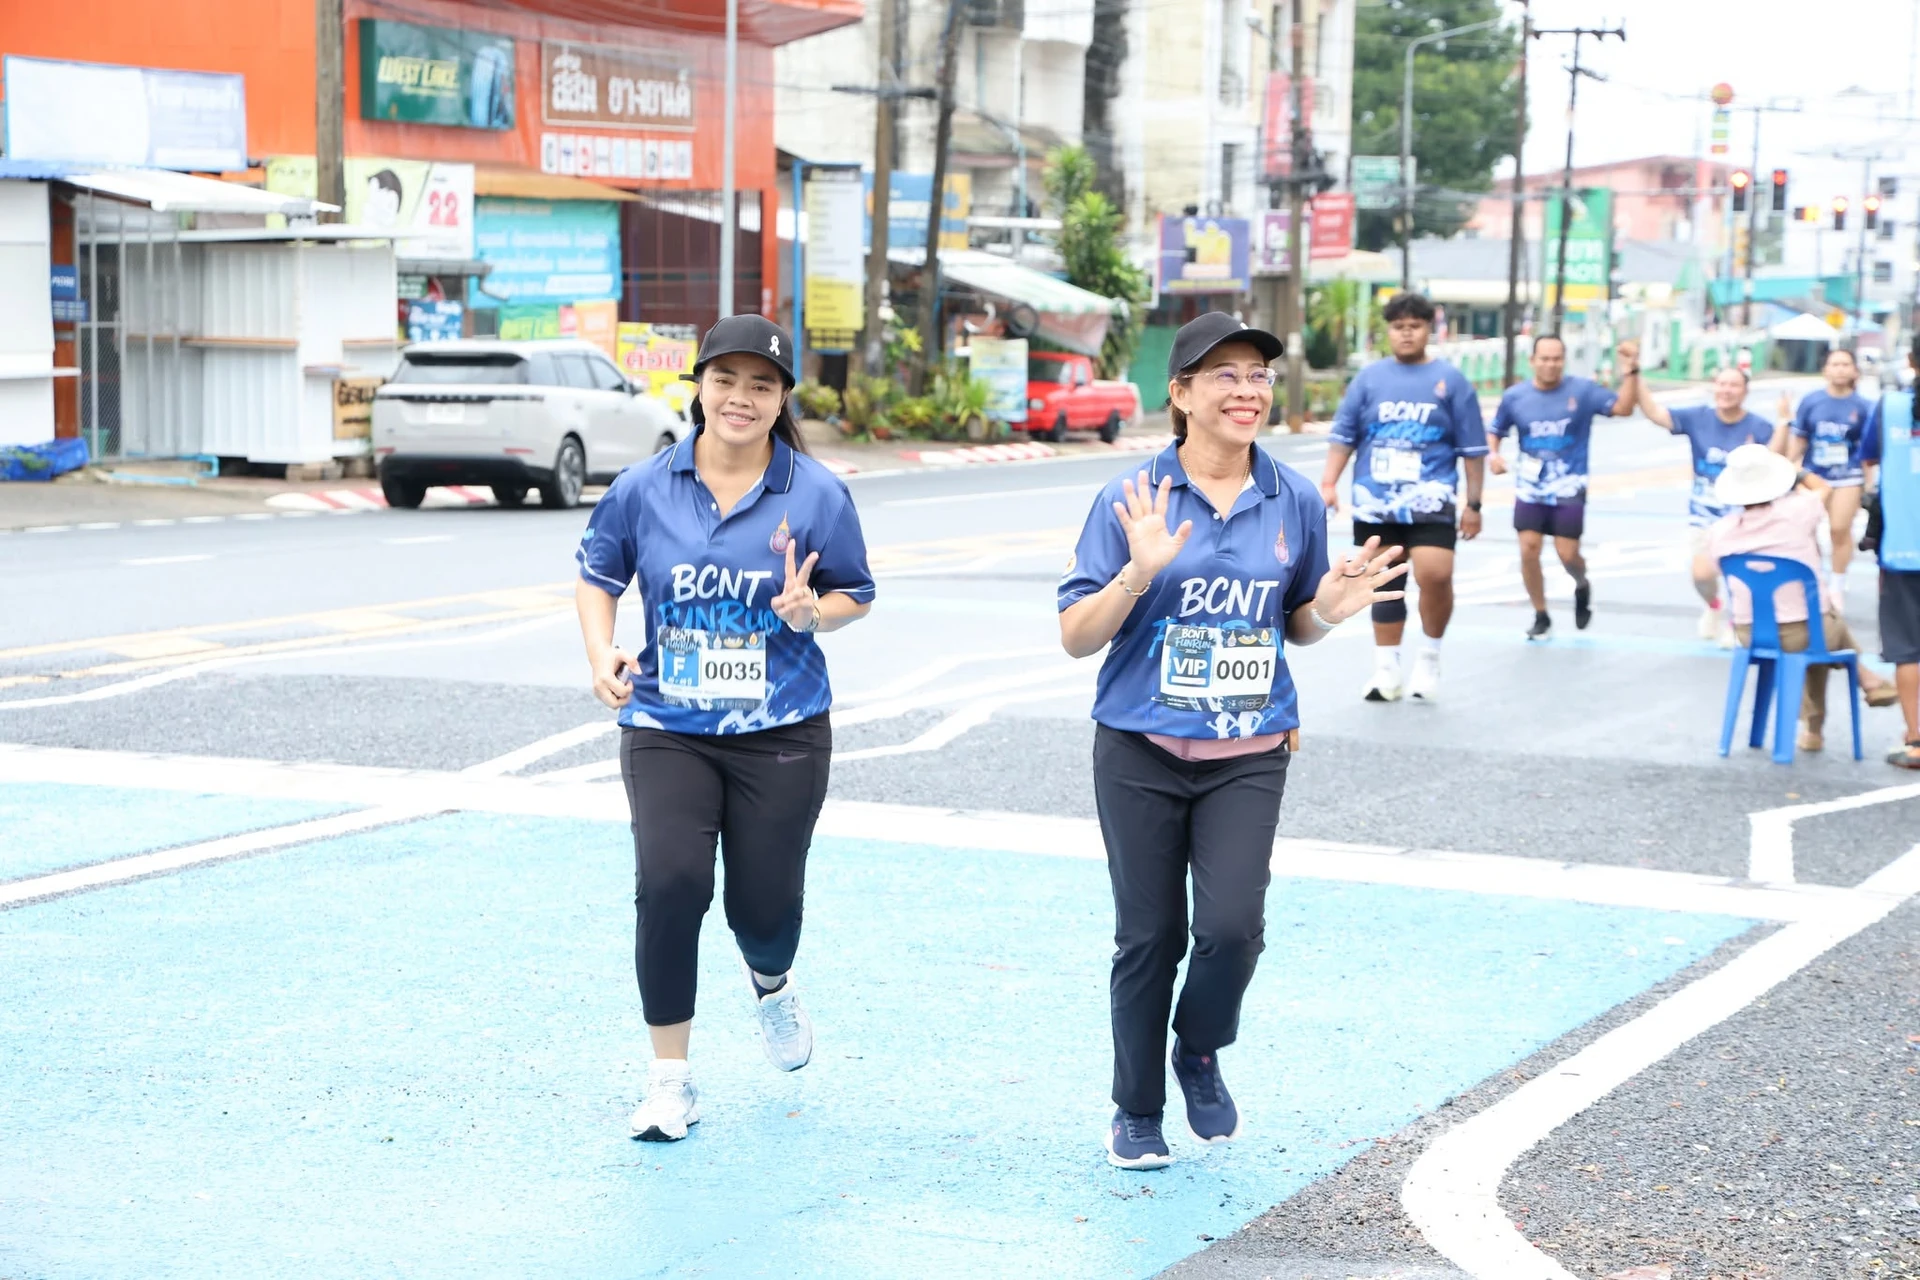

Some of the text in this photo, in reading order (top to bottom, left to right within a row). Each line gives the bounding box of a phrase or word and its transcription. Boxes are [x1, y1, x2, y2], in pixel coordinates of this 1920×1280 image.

[428, 190, 460, 226] 22
[1378, 400, 1438, 424] BCNT
[671, 563, 773, 608] BCNT
[1178, 576, 1280, 622] BCNT
[1174, 637, 1211, 650] FUNRUN
[1181, 628, 1206, 640] BCNT
[673, 657, 686, 676] F
[705, 661, 762, 681] 0035
[1172, 656, 1208, 676] VIP
[1216, 659, 1270, 680] 0001
